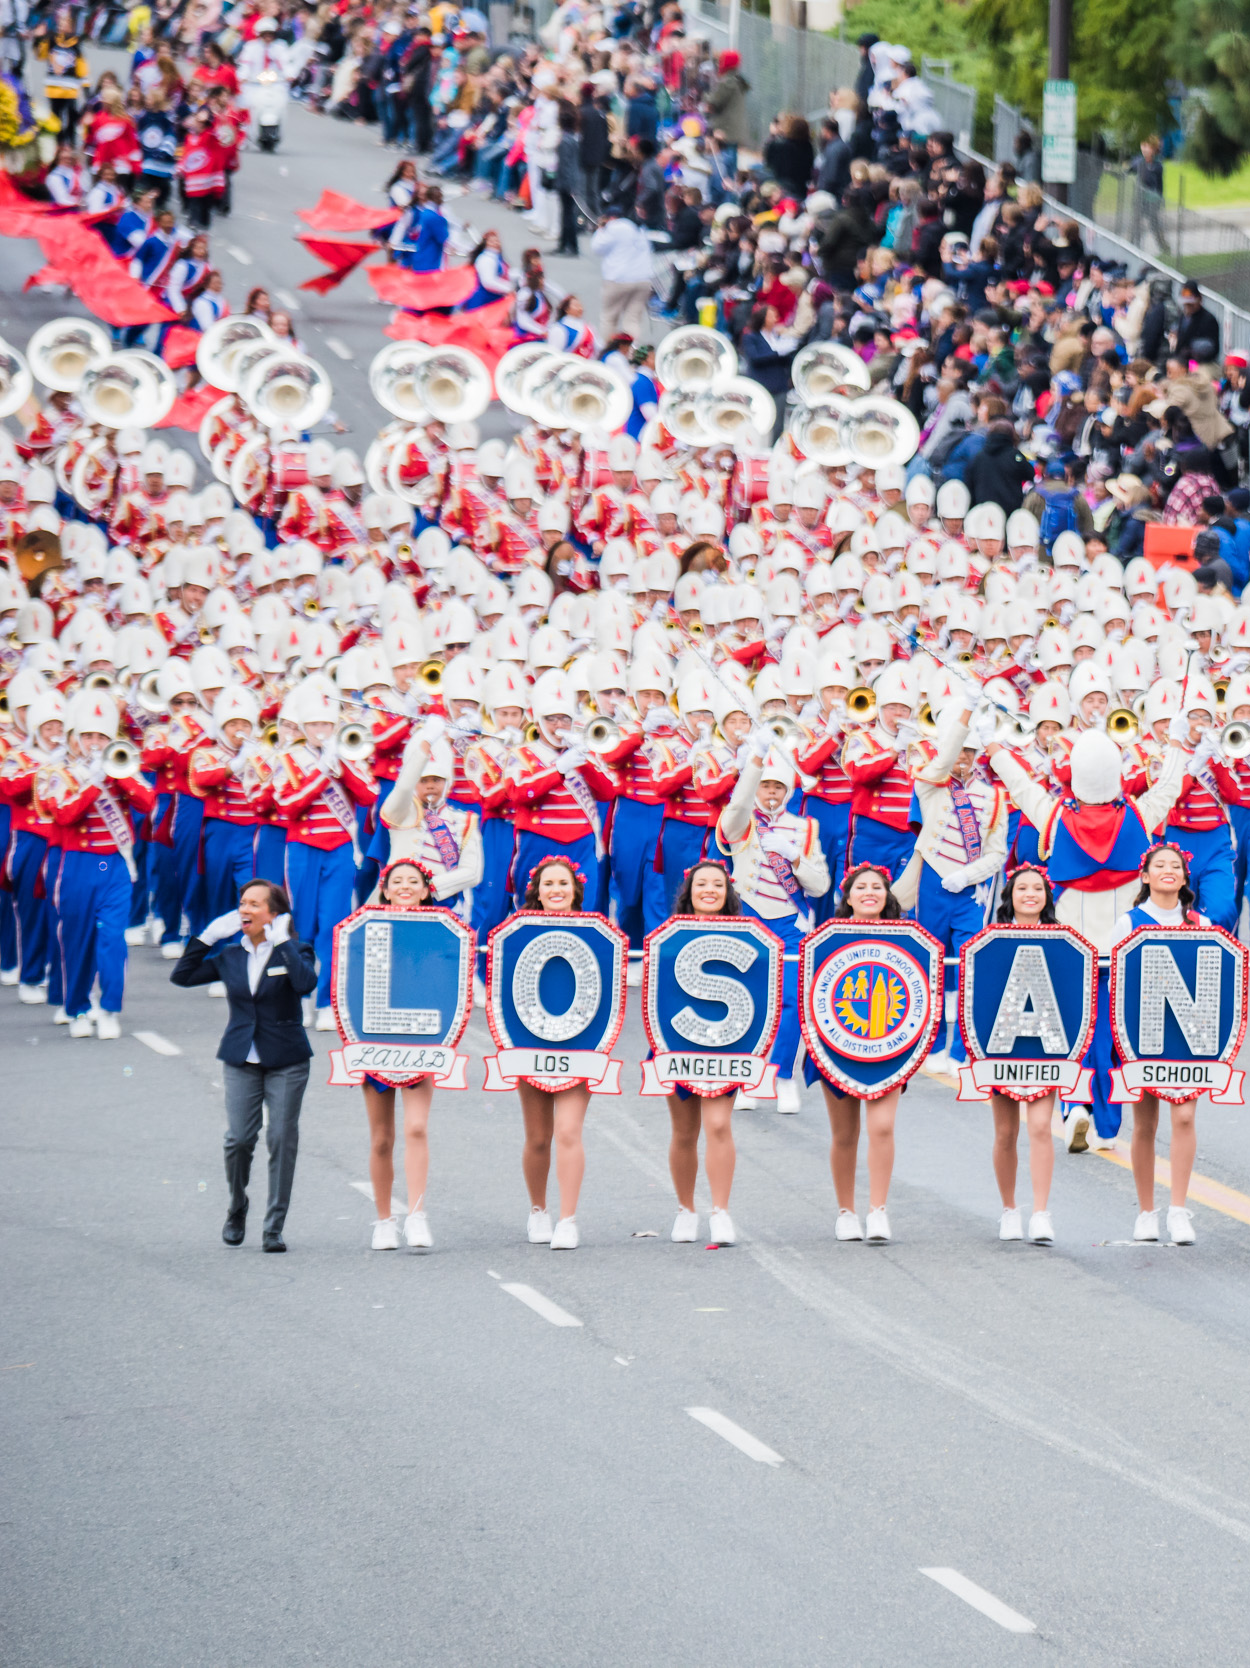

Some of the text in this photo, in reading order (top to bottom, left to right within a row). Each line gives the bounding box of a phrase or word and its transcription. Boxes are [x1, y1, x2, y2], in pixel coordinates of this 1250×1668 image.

[97, 798, 129, 847] ANGELES
[325, 786, 355, 827] NGELES
[433, 830, 459, 872] ANGEL
[957, 808, 981, 862] ANGELES
[362, 922, 442, 1035] L
[512, 930, 601, 1042] O
[670, 934, 760, 1048] S
[817, 948, 925, 1018] LOS ANGELES UNIFIED SCHOOL DISTRICT
[985, 944, 1070, 1055] A
[1138, 944, 1222, 1056] N
[351, 1046, 446, 1068] LAUSD
[827, 1027, 908, 1054] ALL DISTRICT BAND
[533, 1054, 571, 1073] LOS
[667, 1057, 753, 1078] ANGELES
[993, 1064, 1060, 1082] UNIFIED
[1142, 1065, 1214, 1083] SCHOOL
